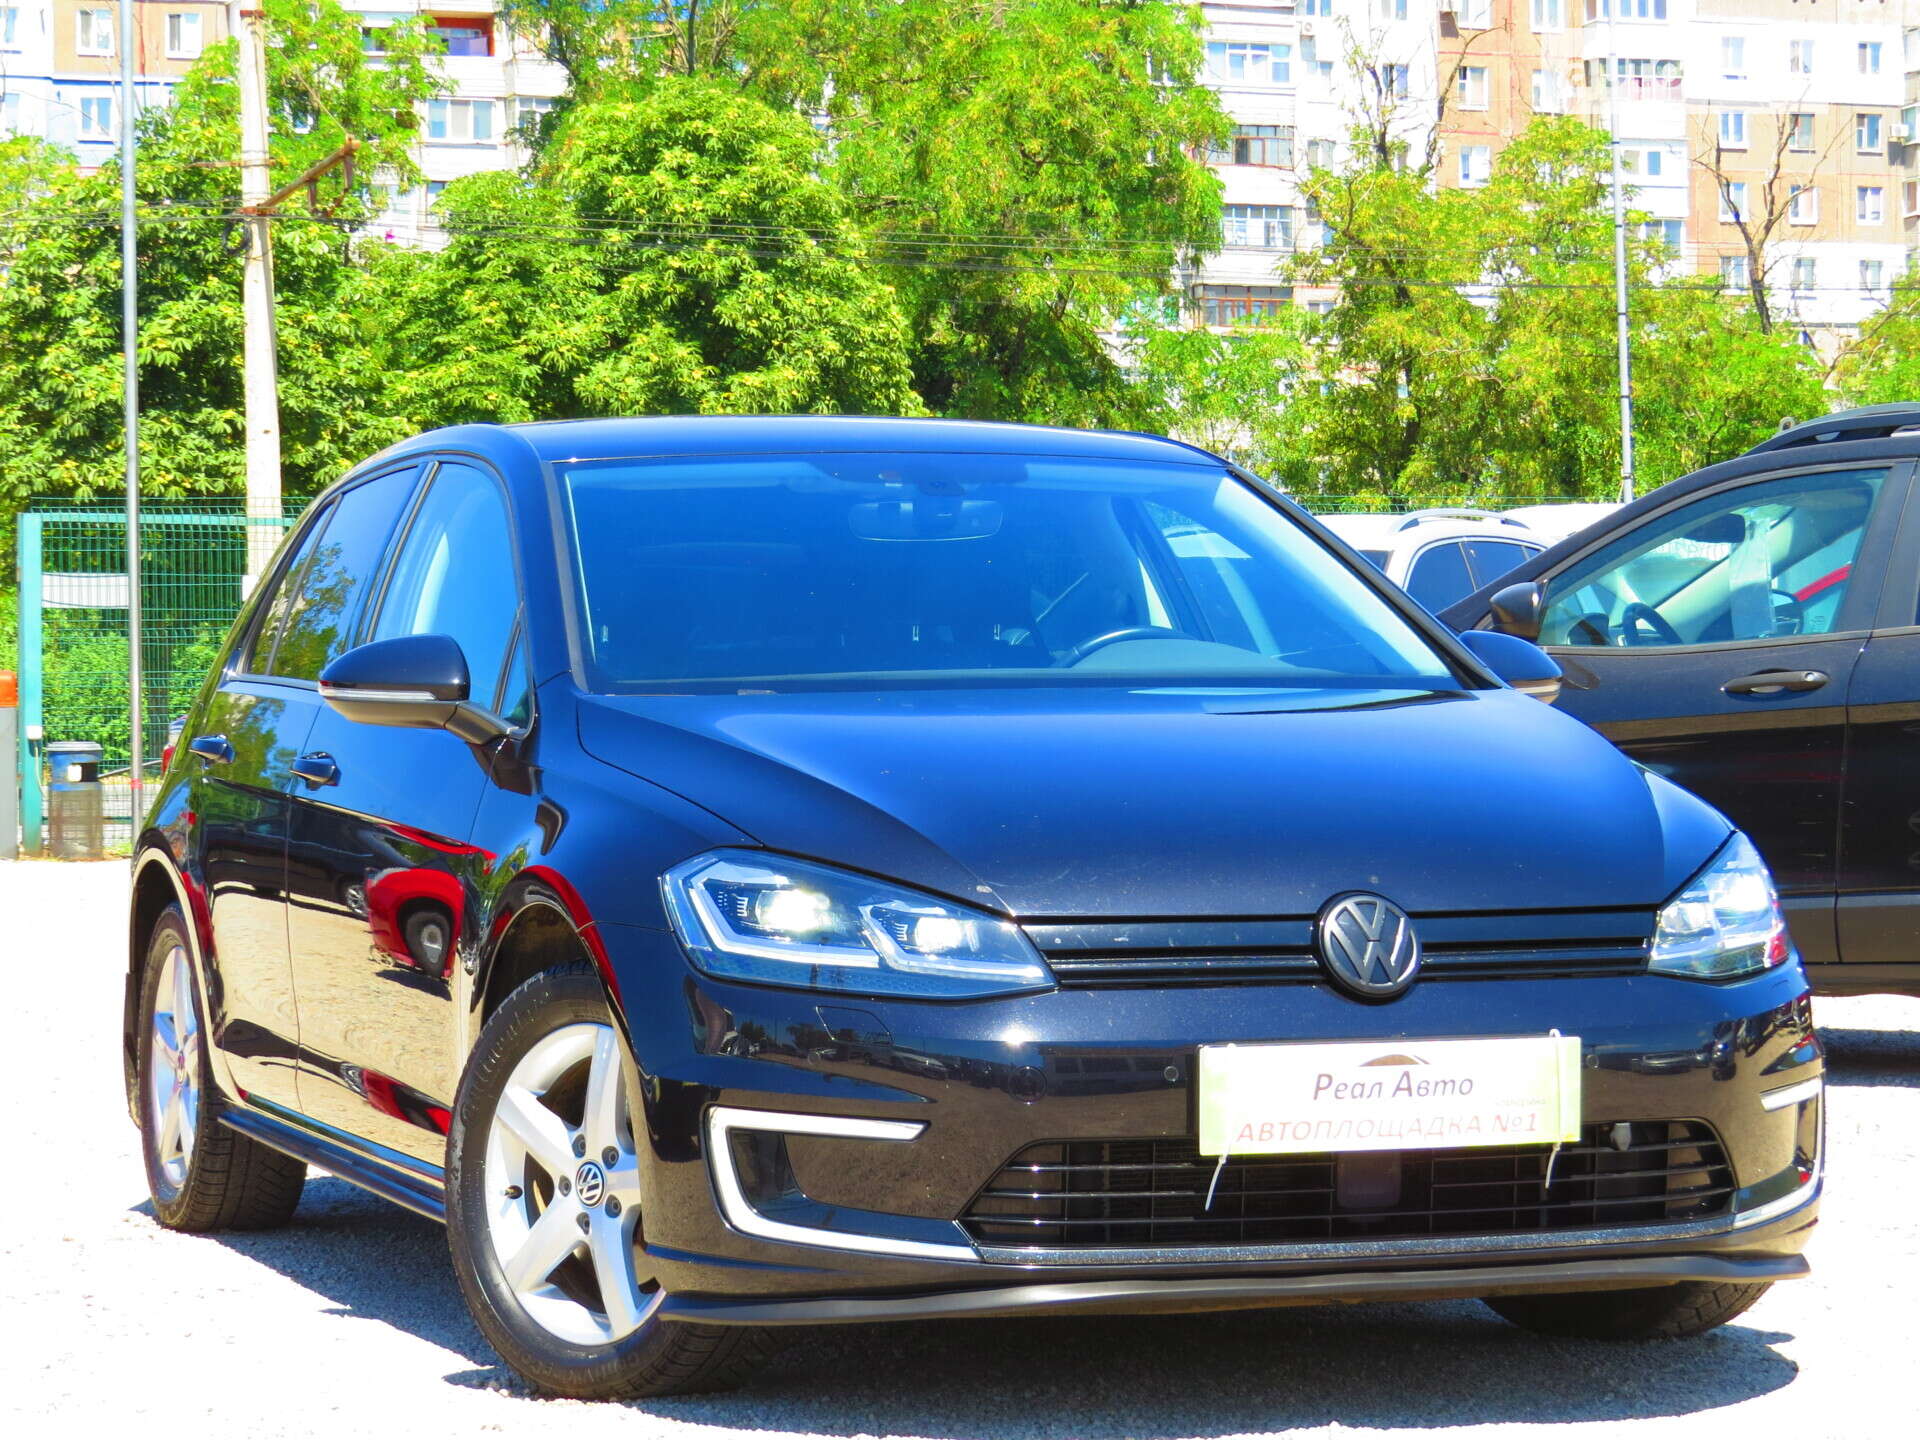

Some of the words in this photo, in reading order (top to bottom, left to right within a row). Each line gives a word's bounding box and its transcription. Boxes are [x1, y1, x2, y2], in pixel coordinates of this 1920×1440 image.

[1313, 1073, 1383, 1100] Реал
[1392, 1070, 1474, 1097] Авто
[1236, 1113, 1481, 1142] АВТОПЛОЩАДКА
